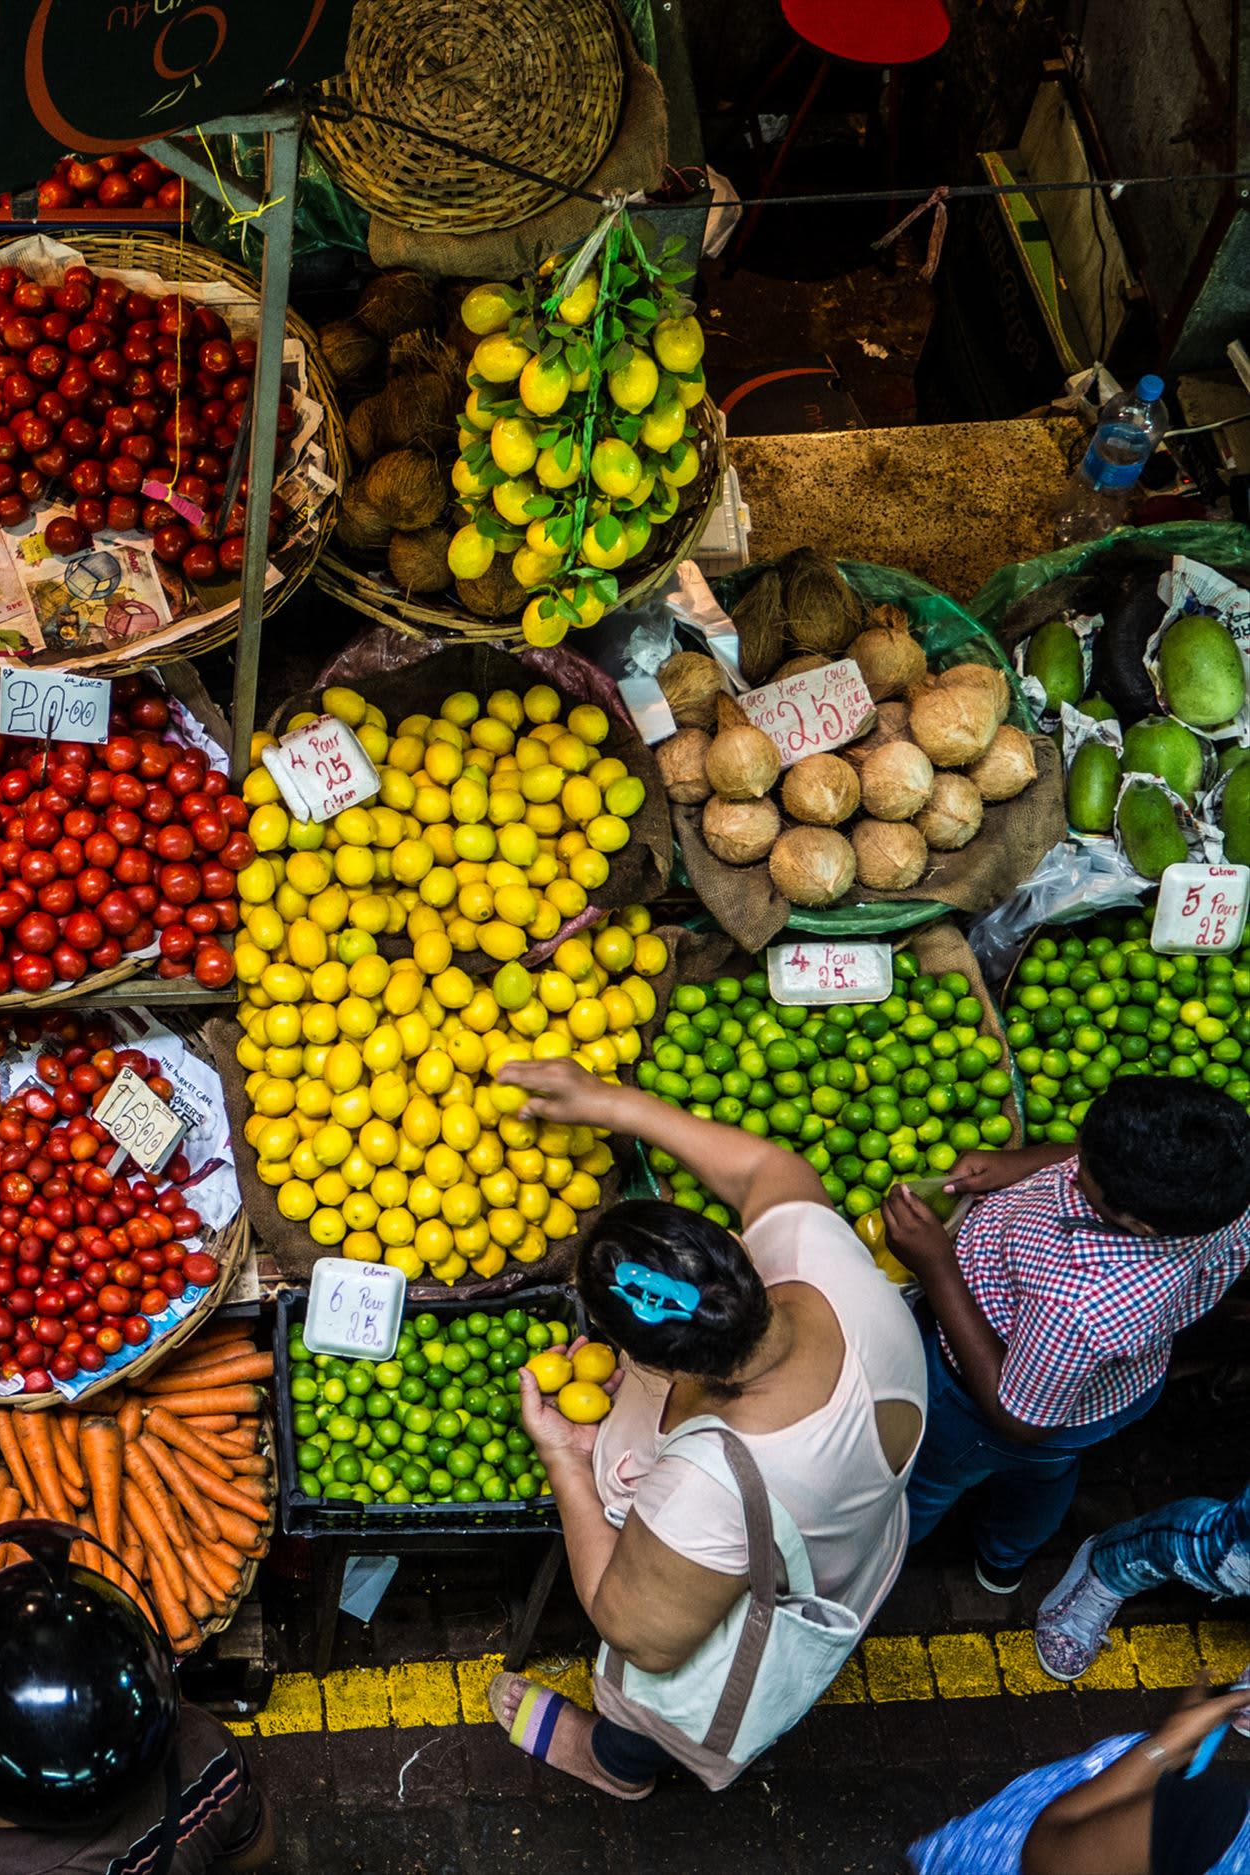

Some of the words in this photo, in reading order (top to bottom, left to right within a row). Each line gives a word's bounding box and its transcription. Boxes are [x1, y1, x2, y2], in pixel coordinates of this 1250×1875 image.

[8, 680, 97, 734] 20.00
[308, 731, 341, 756] Pour
[315, 752, 353, 791] 25
[323, 789, 357, 816] Citron
[1182, 883, 1205, 917] 5
[1211, 892, 1239, 916] Pour
[1196, 916, 1227, 945] 25
[823, 943, 857, 965] Pour
[160, 1056, 174, 1071] THE
[172, 1069, 197, 1093] MRKET
[100, 1084, 164, 1156] 15.00
[174, 1096, 205, 1122] OVER'S
[329, 1280, 345, 1312] 6
[359, 1286, 386, 1311] Pour
